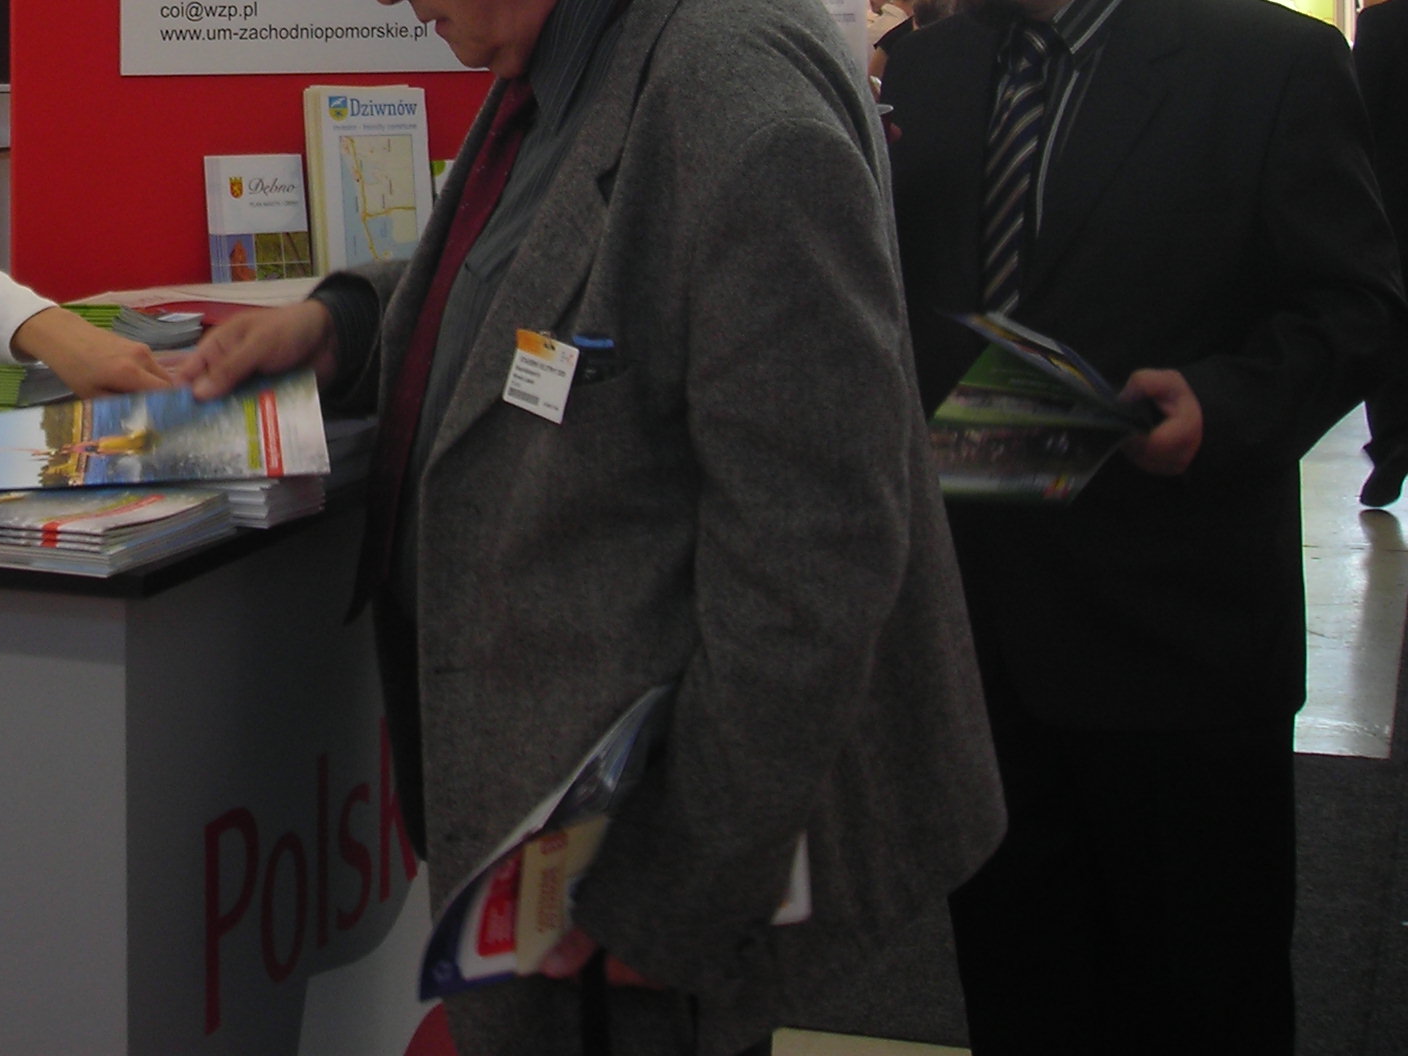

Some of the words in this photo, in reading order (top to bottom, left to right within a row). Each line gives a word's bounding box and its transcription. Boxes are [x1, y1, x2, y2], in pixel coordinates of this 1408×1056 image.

[160, 1, 258, 21] coi@wzp.pl
[160, 23, 428, 42] www.um-zachodniopomorskie.pl
[350, 98, 418, 117] Dziwnów
[248, 177, 296, 196] Dębno
[204, 715, 418, 1036] Polsk
